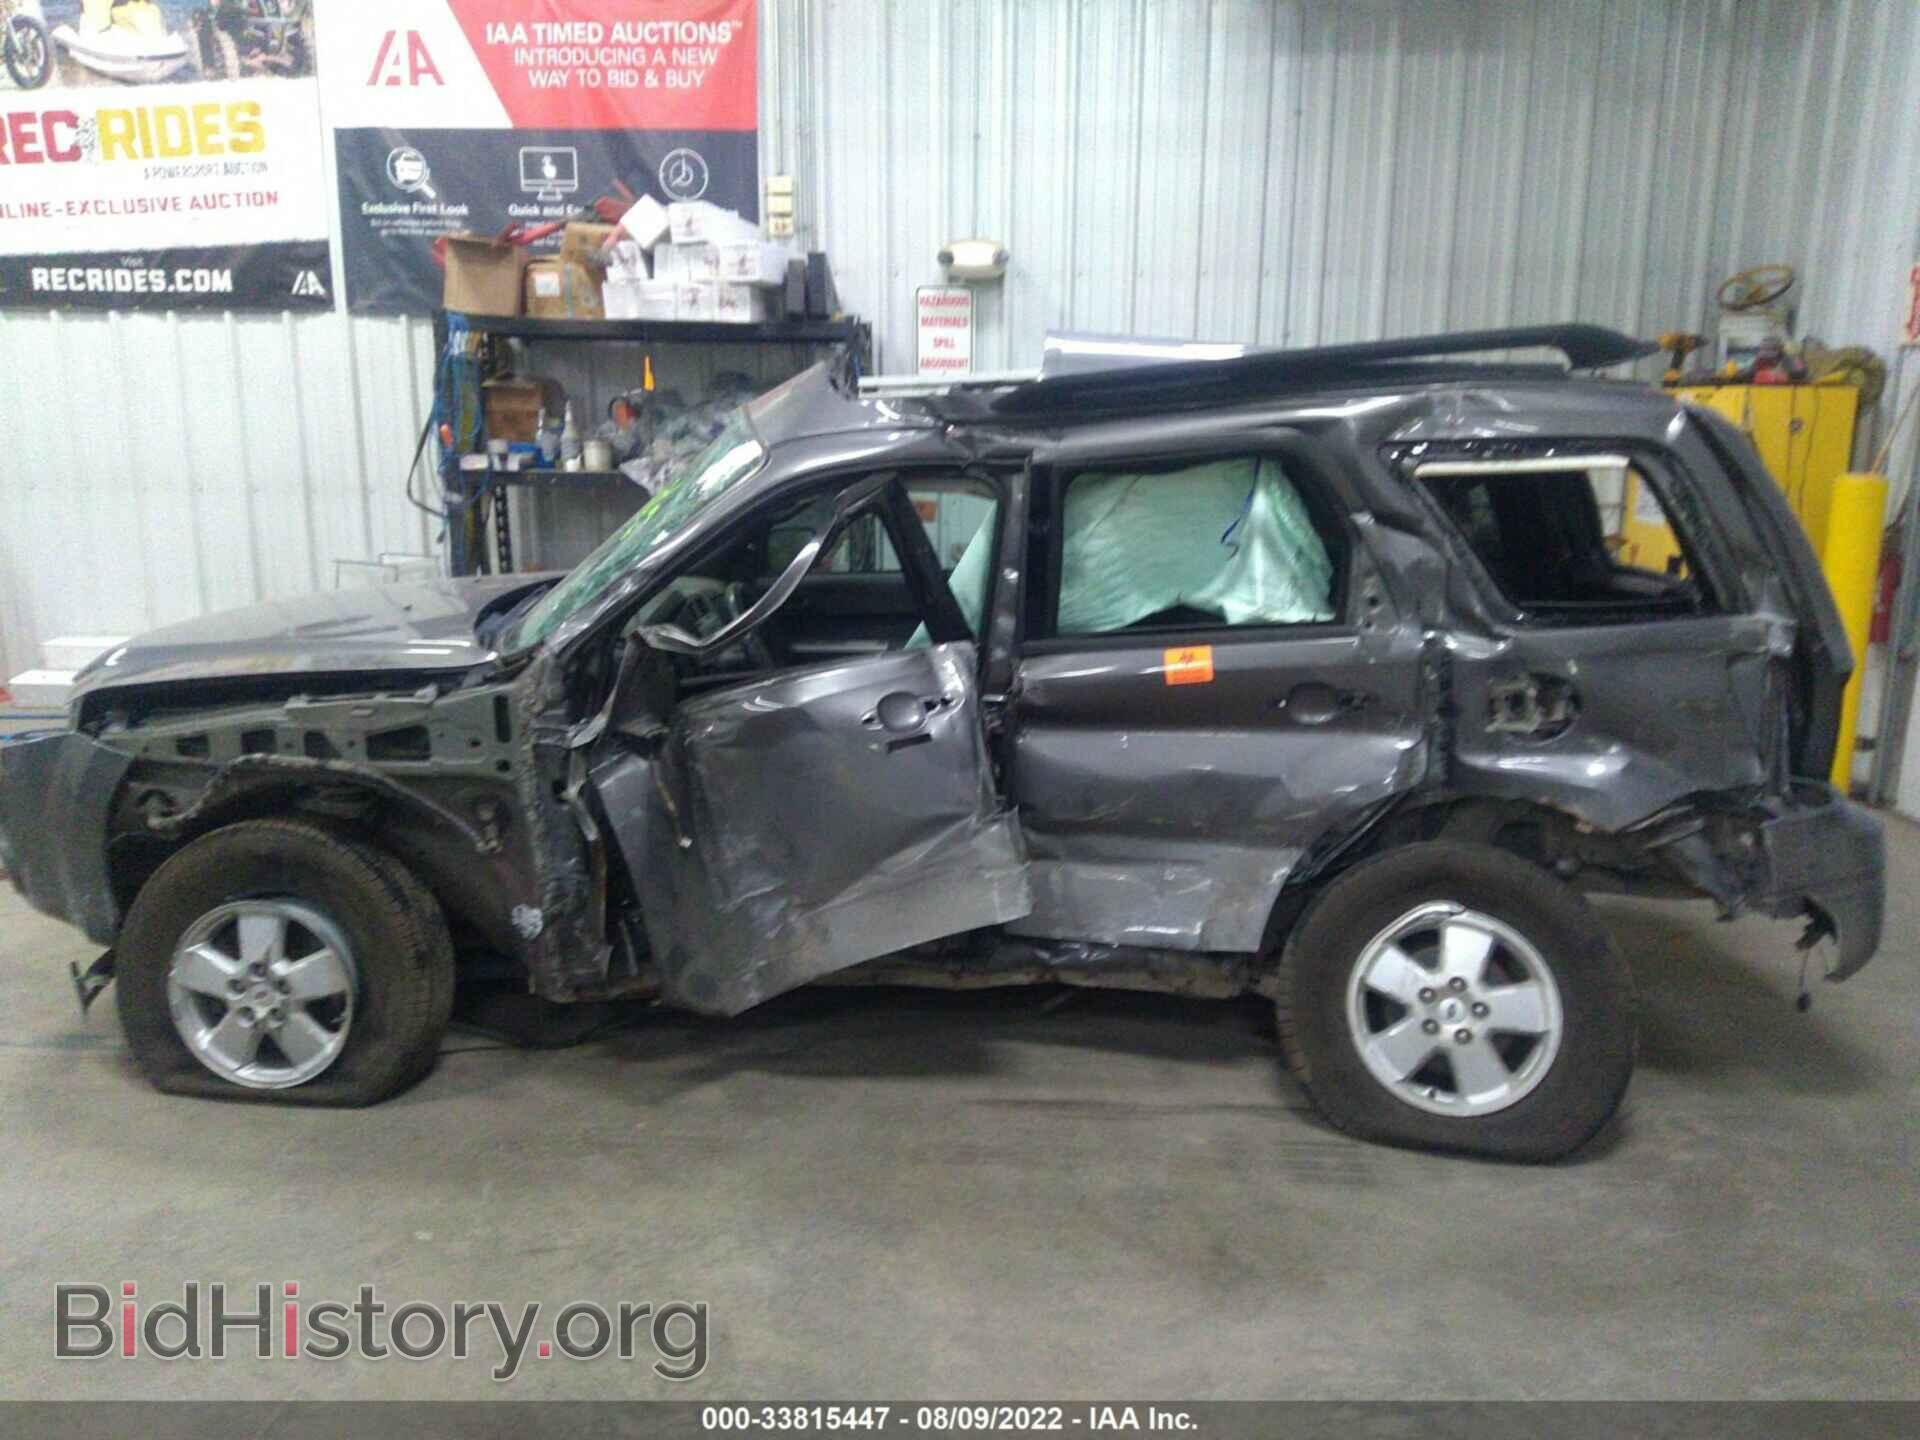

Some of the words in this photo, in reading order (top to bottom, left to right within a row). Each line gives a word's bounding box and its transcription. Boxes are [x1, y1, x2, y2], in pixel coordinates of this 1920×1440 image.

[487, 23, 528, 44] IAA
[532, 22, 603, 44] TIMED
[514, 47, 645, 66] INTRODUCING
[652, 48, 667, 65] A
[672, 47, 718, 65] NEW
[529, 69, 569, 88] WAY
[576, 69, 601, 87] TO
[608, 69, 638, 87] BID
[644, 70, 658, 87] &
[665, 69, 704, 88] BUY
[96, 101, 266, 161] RIDES
[190, 191, 279, 210] AUCTION
[361, 201, 411, 215] Exclusive
[413, 200, 437, 214] First
[440, 202, 468, 216] Look
[508, 203, 540, 216] Quick
[543, 204, 564, 216] and
[32, 267, 233, 293] RECRIDES.COM
[933, 336, 955, 349] SPILL
